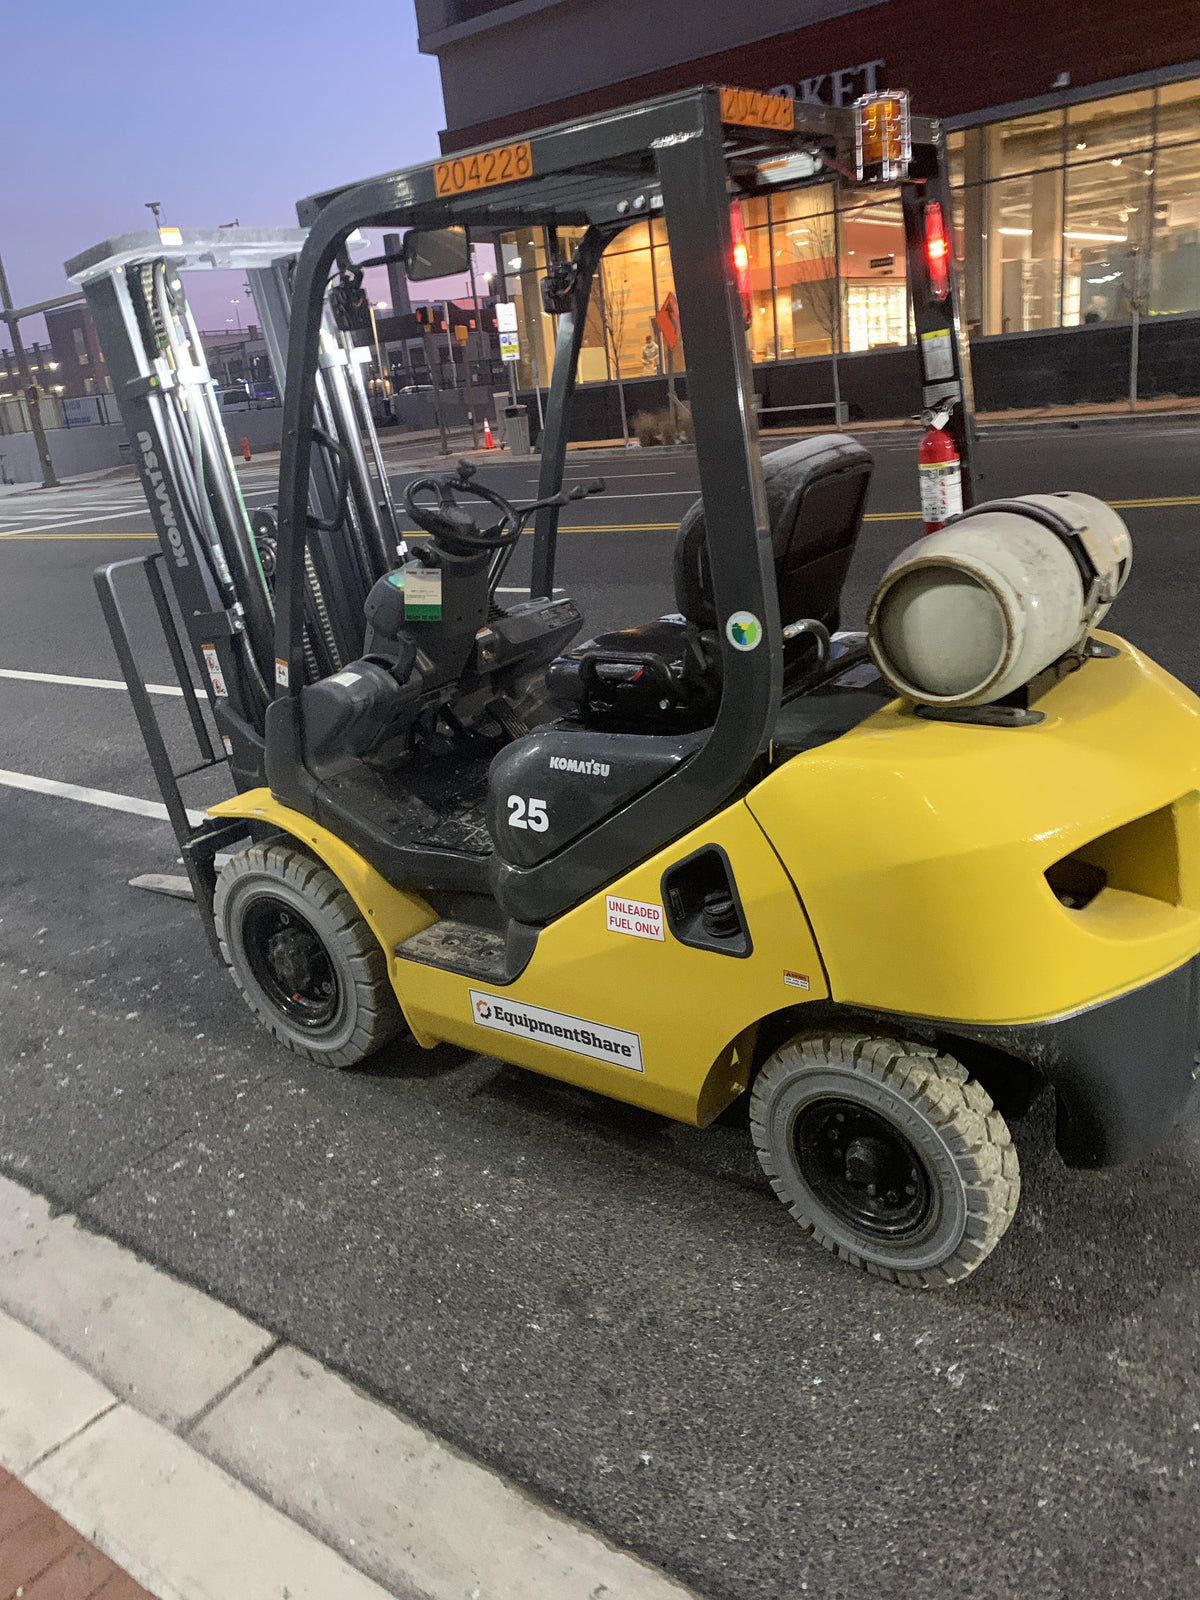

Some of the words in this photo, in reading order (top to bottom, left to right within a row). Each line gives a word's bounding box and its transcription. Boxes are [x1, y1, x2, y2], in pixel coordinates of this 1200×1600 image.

[437, 144, 530, 193] 204228
[136, 430, 190, 568] KOMATSU
[549, 756, 610, 777] KOMATSU
[507, 794, 550, 833] 25
[608, 900, 660, 920] UNLEADED
[609, 915, 633, 931] FUEL
[634, 921, 660, 936] ONLY
[493, 1005, 632, 1057] EquipmentShare
